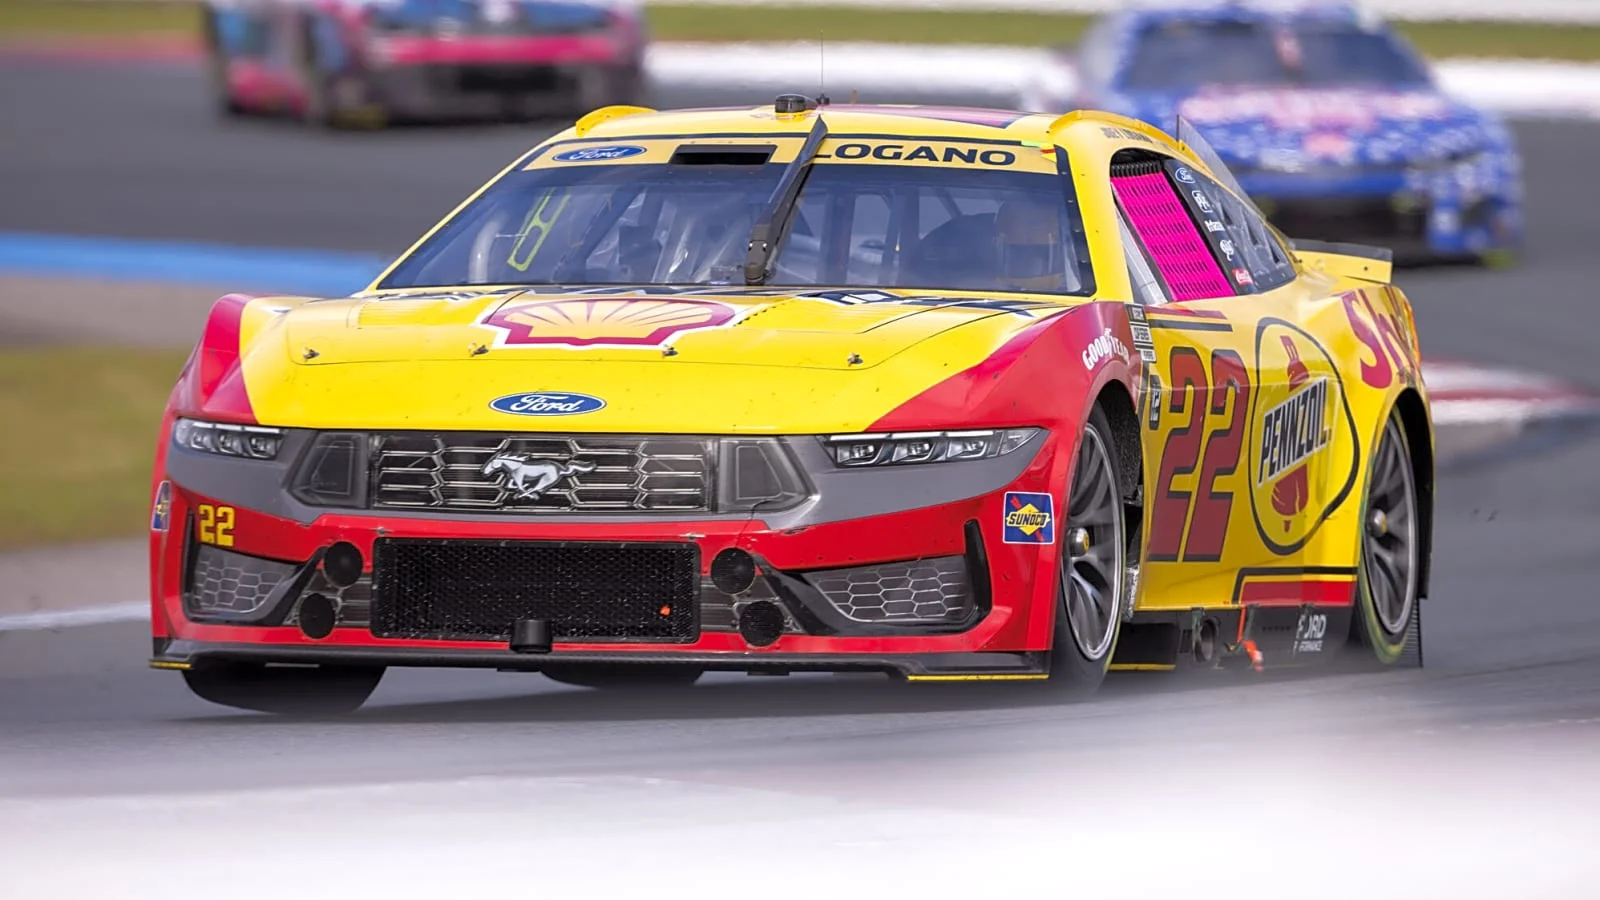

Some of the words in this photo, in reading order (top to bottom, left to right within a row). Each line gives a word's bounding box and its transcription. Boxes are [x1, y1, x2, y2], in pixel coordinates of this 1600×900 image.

[813, 144, 1016, 166] OGANO
[510, 394, 585, 412] Ford
[1147, 346, 1250, 562] 22
[198, 503, 235, 547] 22
[1008, 513, 1048, 526] SUNOCO
